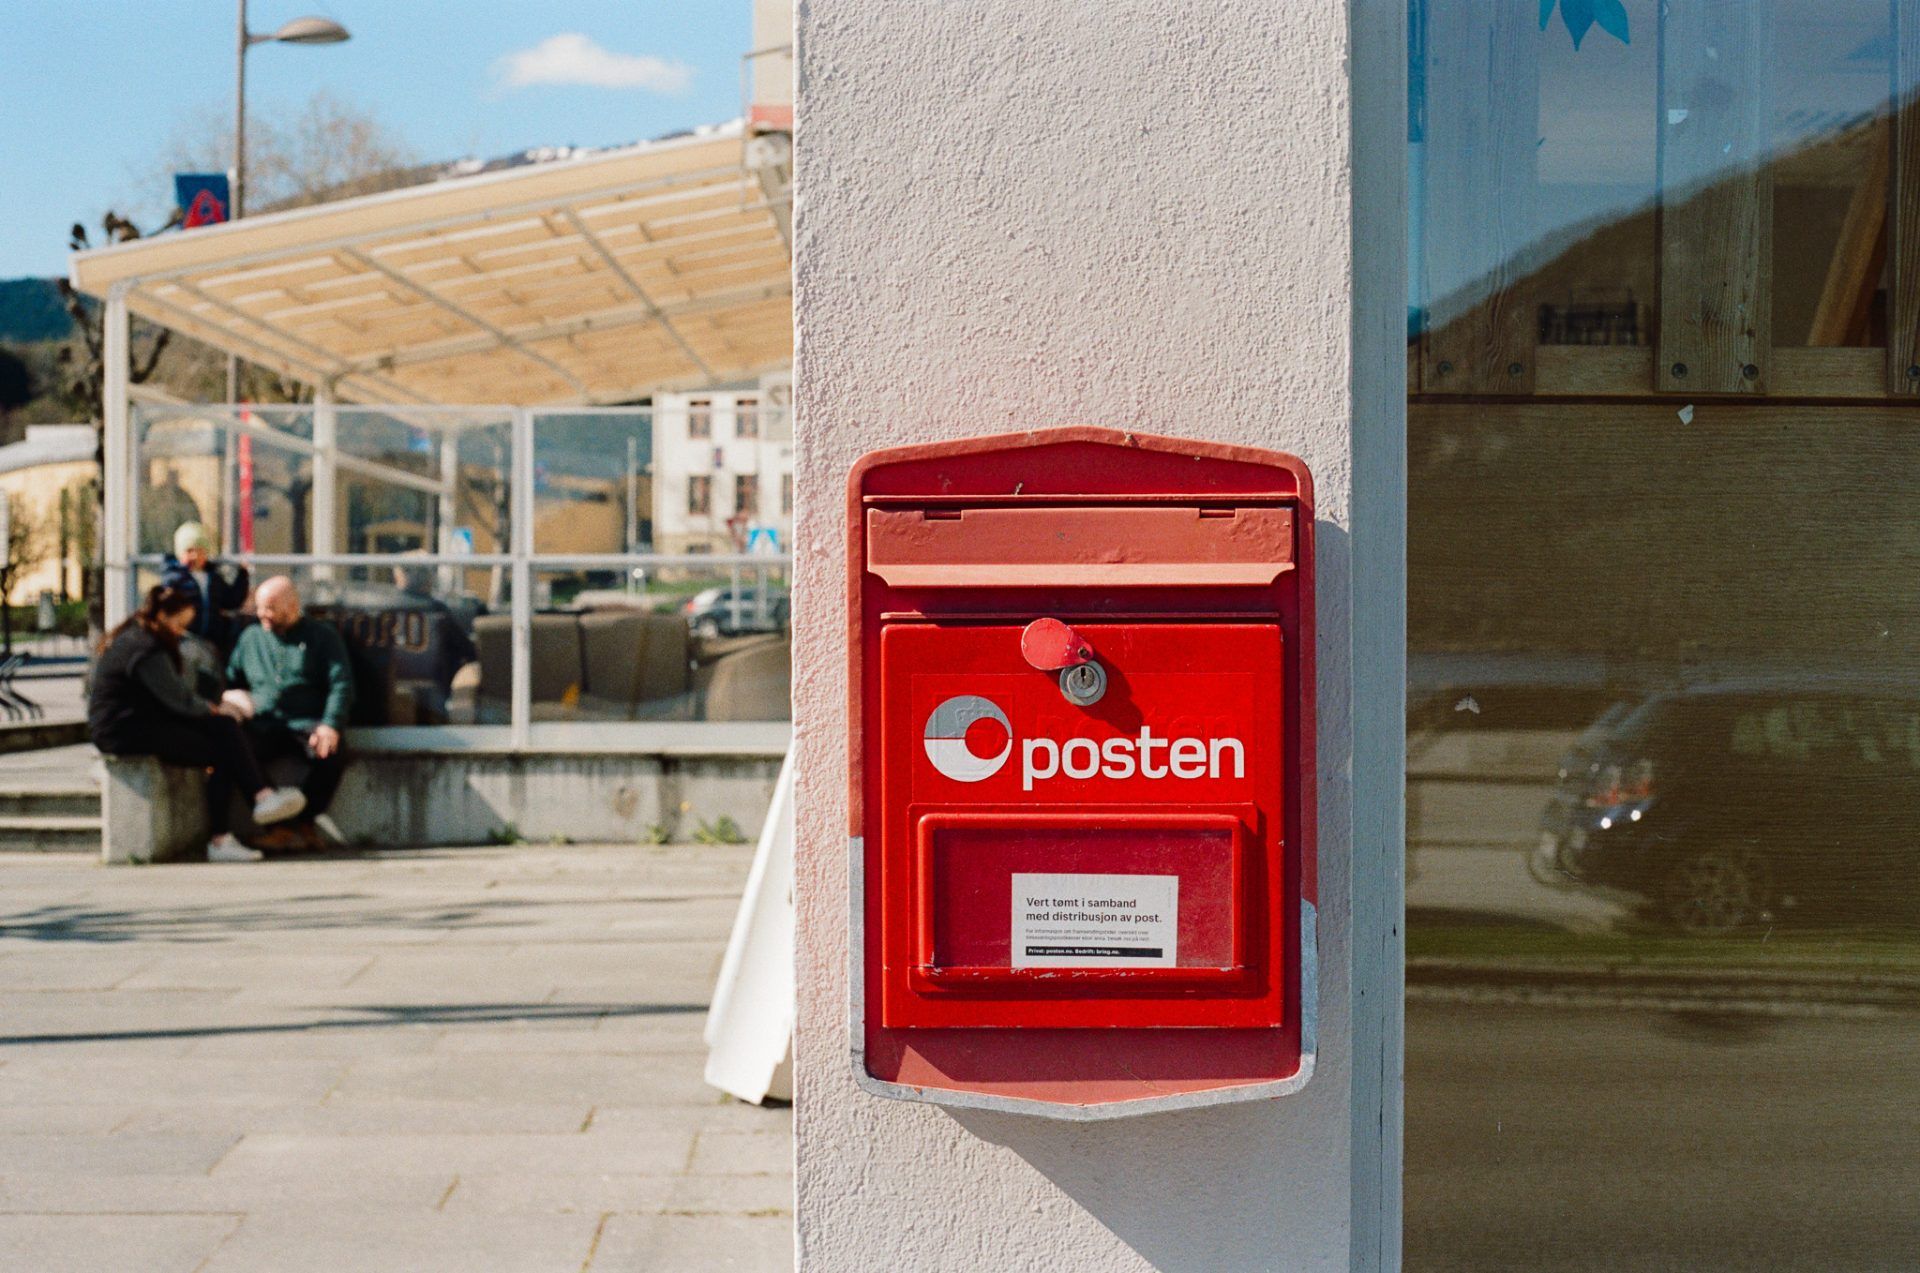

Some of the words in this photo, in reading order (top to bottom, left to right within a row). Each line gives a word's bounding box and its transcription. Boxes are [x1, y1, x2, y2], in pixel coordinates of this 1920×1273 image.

[1022, 725, 1245, 792] posten
[1026, 897, 1050, 907] Vert
[1052, 898, 1079, 908] tømt
[1082, 898, 1085, 908] i
[1087, 898, 1137, 909] samband
[1026, 911, 1050, 921] med
[1052, 912, 1118, 924] distribusjon
[1120, 914, 1132, 923] av
[1134, 913, 1162, 924] post.
